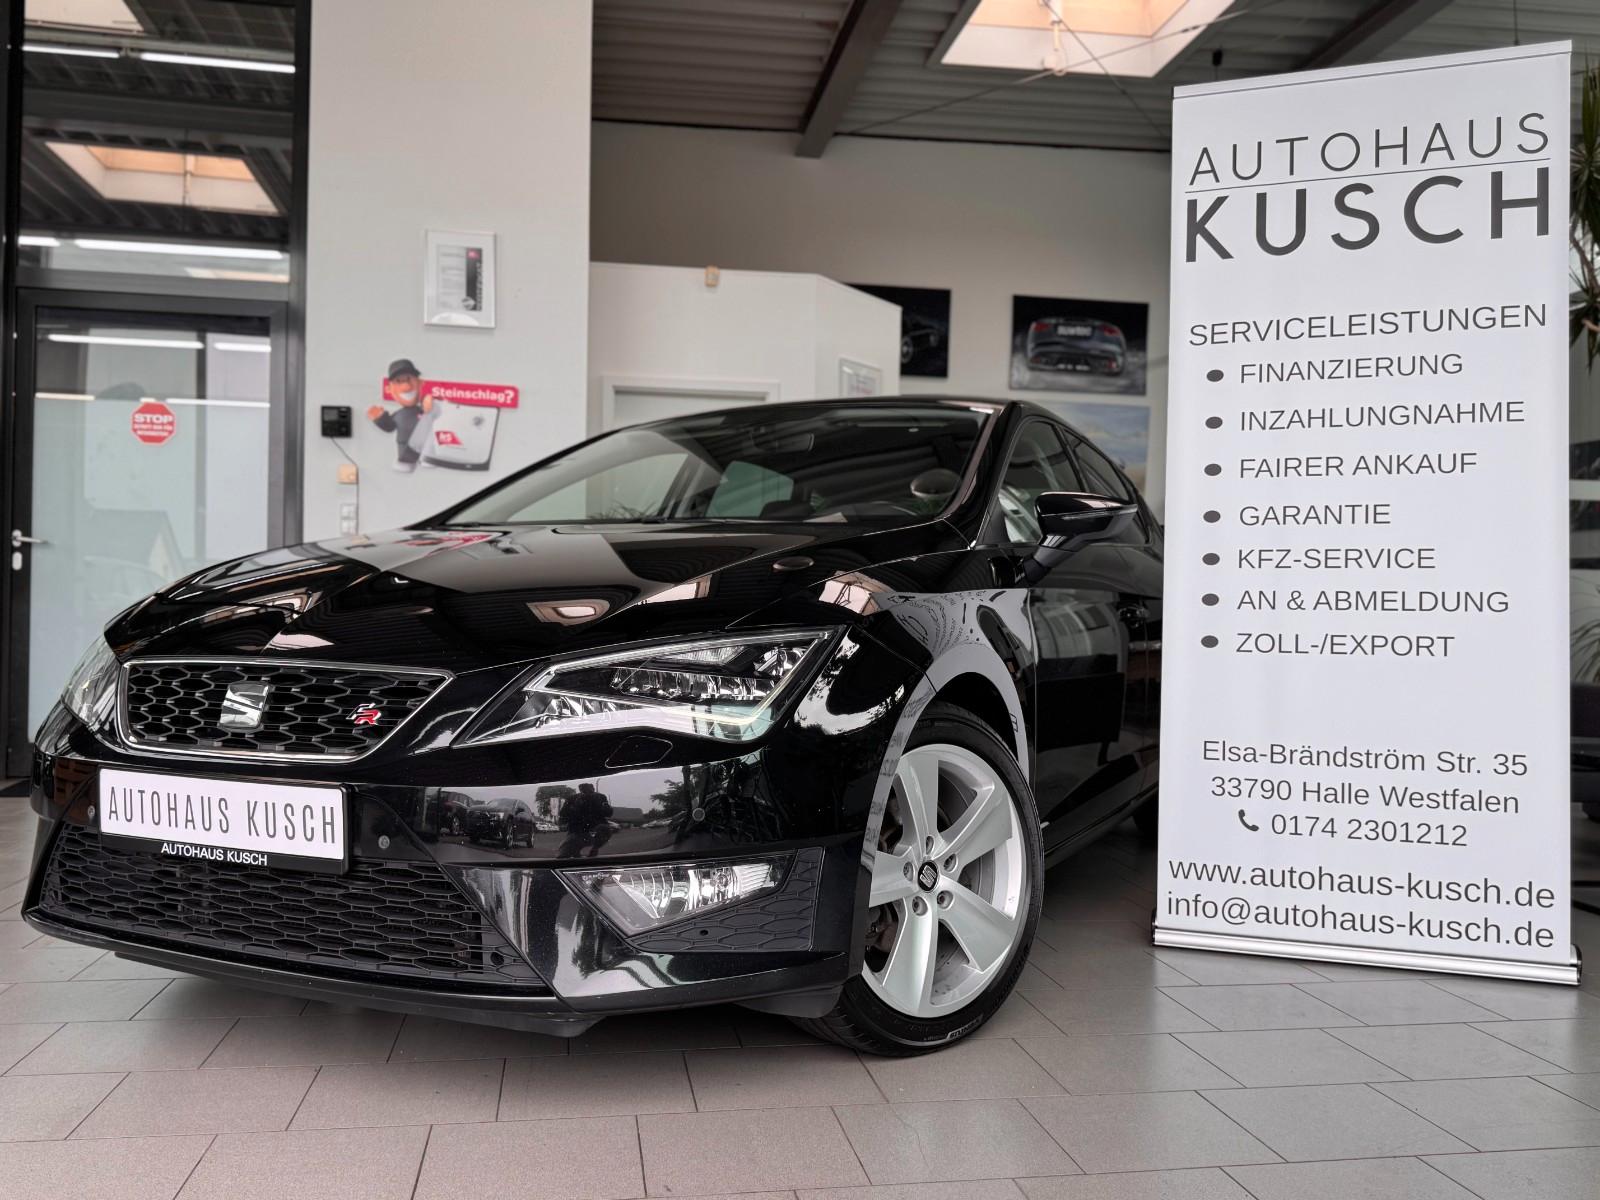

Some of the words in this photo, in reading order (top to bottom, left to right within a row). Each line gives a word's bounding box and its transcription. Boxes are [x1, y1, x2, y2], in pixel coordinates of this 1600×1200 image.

[1188, 112, 1549, 186] AUTOHAUS
[1185, 166, 1550, 263] KUSCH
[1189, 303, 1546, 346] SERVICELEISTUNGEN
[1240, 353, 1463, 383] FINANZIERUNG
[431, 386, 515, 404] Steinschlag?
[134, 413, 173, 424] STOP
[1241, 401, 1525, 431] INZAHLUNGNAHME
[1240, 456, 1344, 479] FAIRER
[1352, 452, 1477, 476] ANKAUF
[1239, 503, 1391, 526] GARANTIE
[1238, 548, 1436, 569] KFZ-SERVICE
[1236, 590, 1277, 611] AN
[1286, 590, 1306, 611] &
[1312, 590, 1509, 613] ABMELDUNG
[1236, 632, 1455, 657] ZOLL-/EXPORT
[1203, 740, 1425, 771] Elsa-Brändström
[1436, 751, 1481, 774] Str.
[1493, 753, 1528, 776] 35
[1211, 776, 1292, 801] 33790
[1302, 781, 1370, 806] Halle
[1379, 785, 1519, 814] Westfalen
[108, 786, 230, 834] AUTOHAUS
[246, 800, 335, 844] KUSCH
[1271, 814, 1338, 838] 0174
[1347, 818, 1467, 847] 2301212
[161, 841, 224, 861] AUTOHAUS
[226, 849, 268, 866] KUSCH
[1168, 860, 1555, 909] www.autohaus-kusch.de
[1167, 890, 1554, 948] info@autohaus-kusch.de
